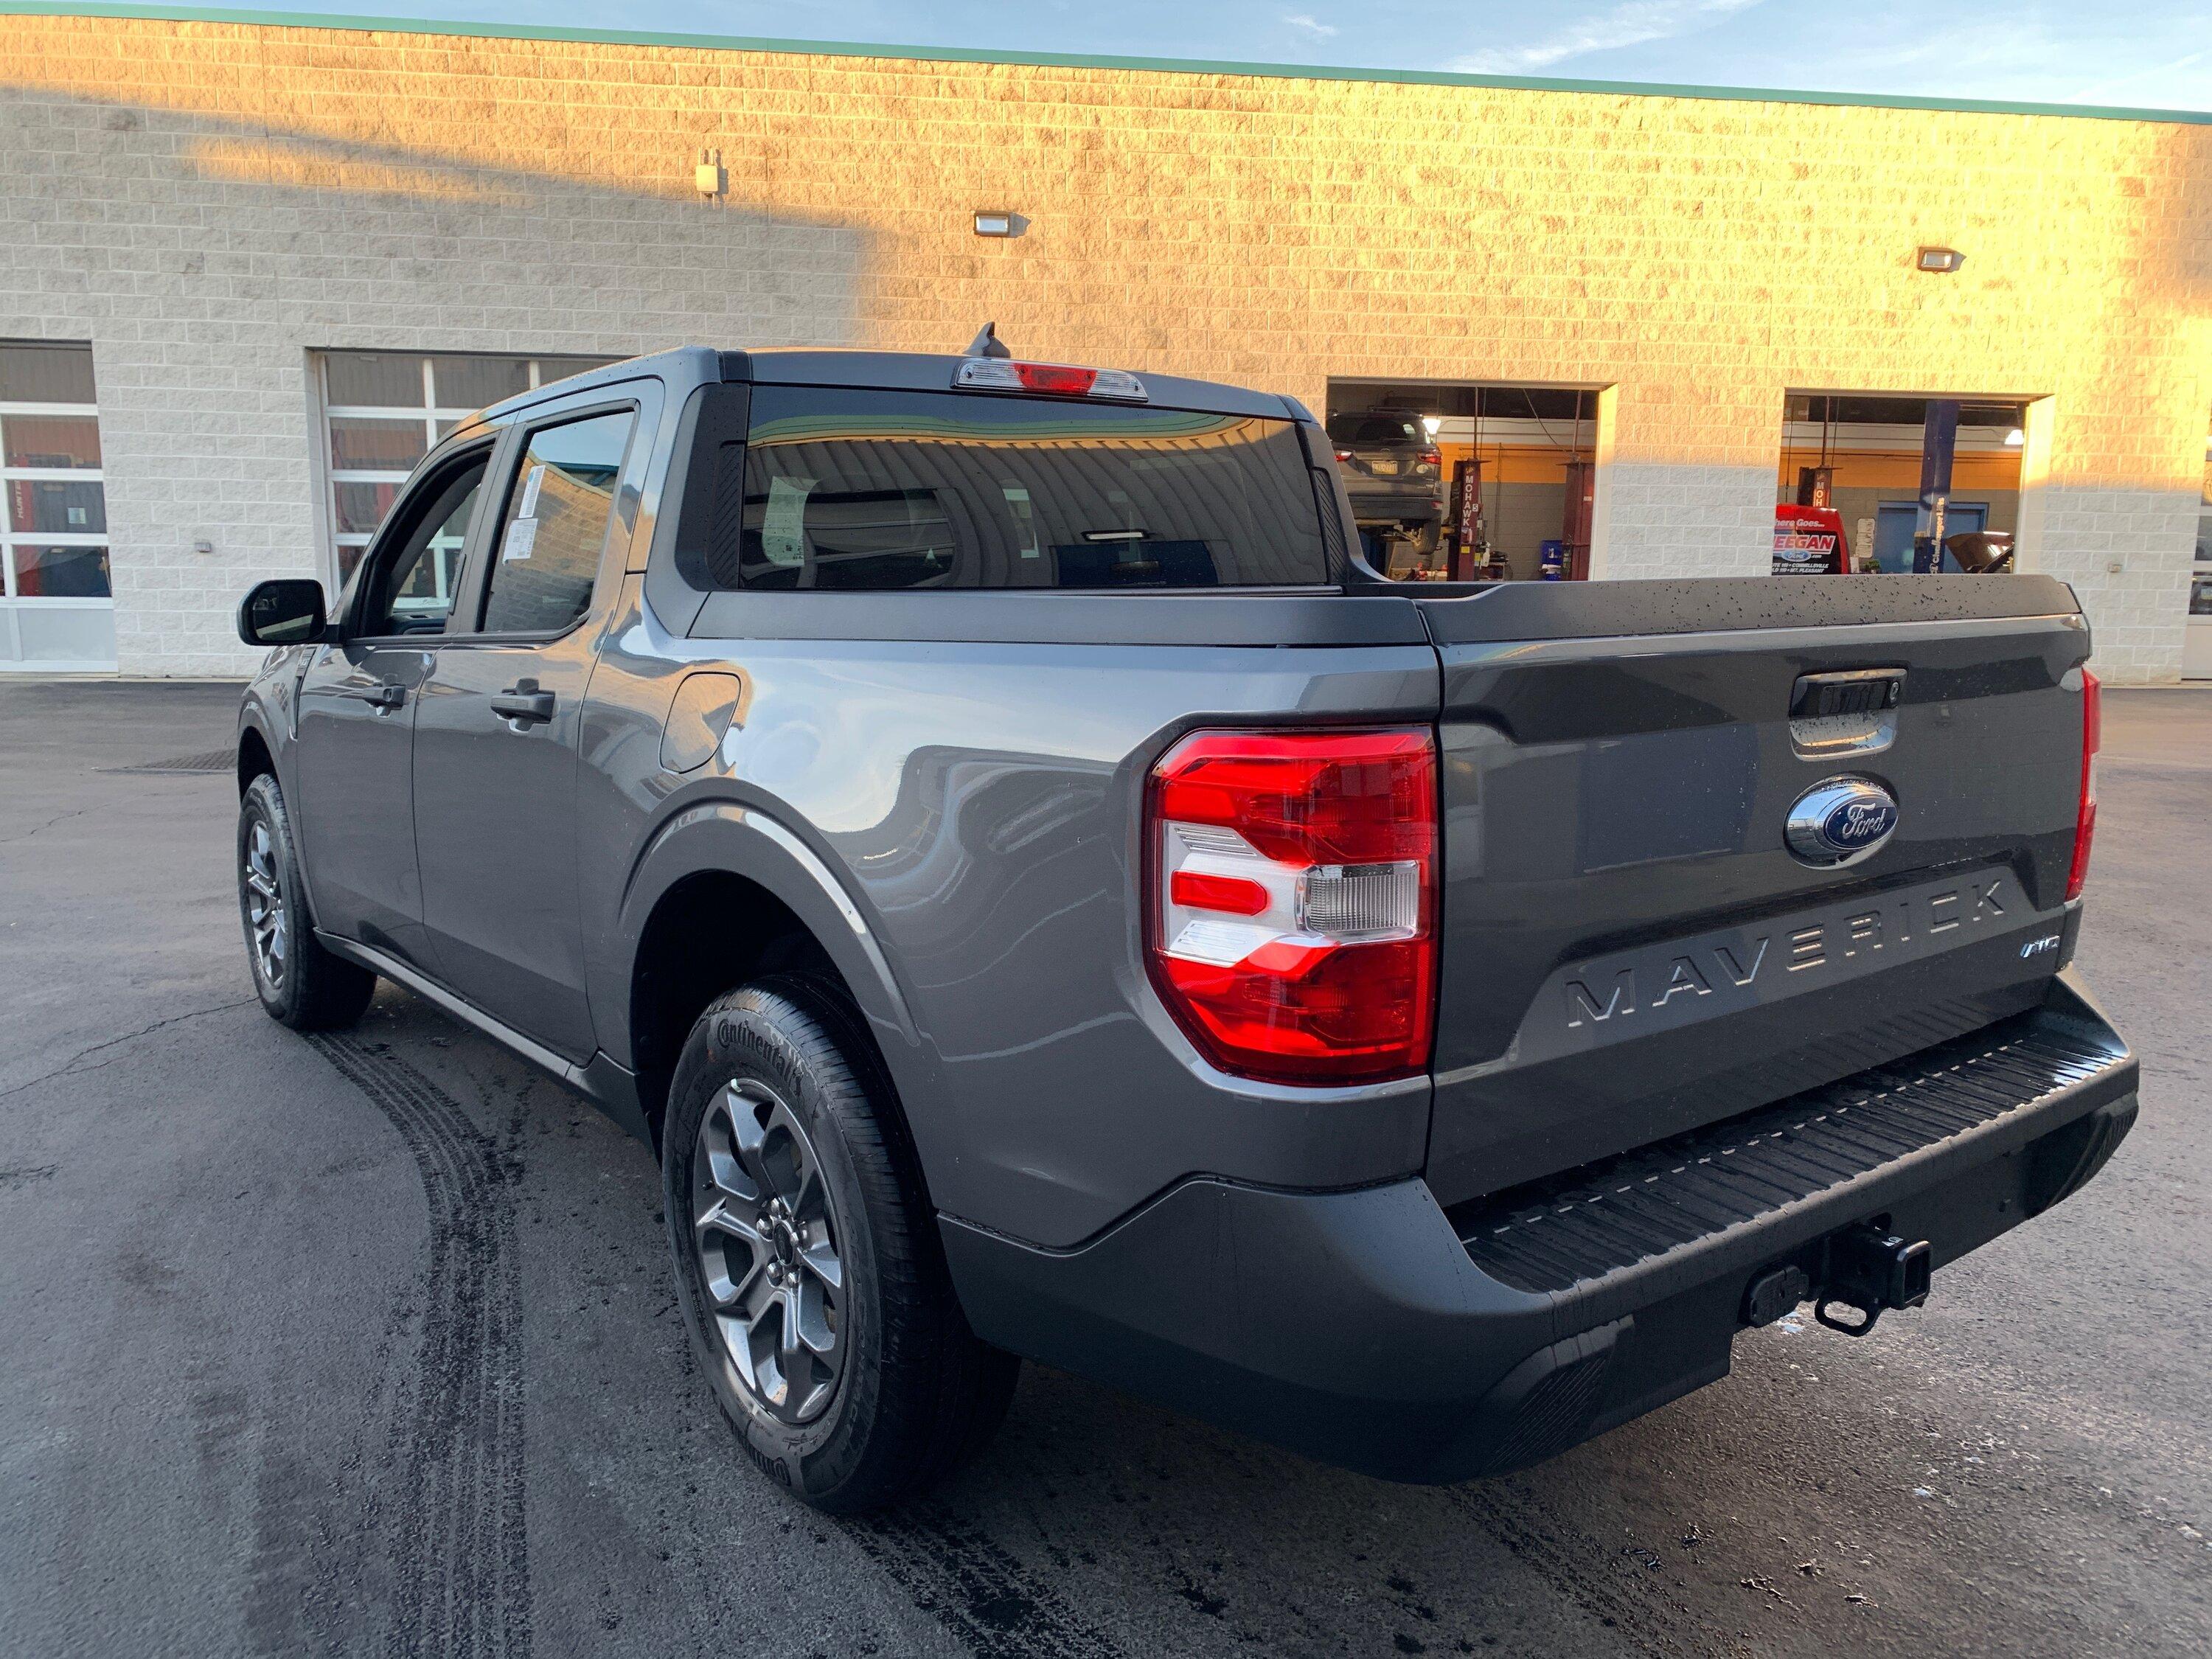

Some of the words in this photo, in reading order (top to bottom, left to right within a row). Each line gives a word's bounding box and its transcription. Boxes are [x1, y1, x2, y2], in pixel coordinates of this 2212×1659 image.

[1463, 476, 1474, 526] MOHAWK
[1816, 481, 1824, 507] MOH
[1775, 518, 1795, 526] here
[1773, 535, 1835, 549] EEGAN
[1843, 802, 1886, 839] Ford
[1565, 878, 2004, 1027] MAVERICK
[717, 1018, 793, 1083] Continental
